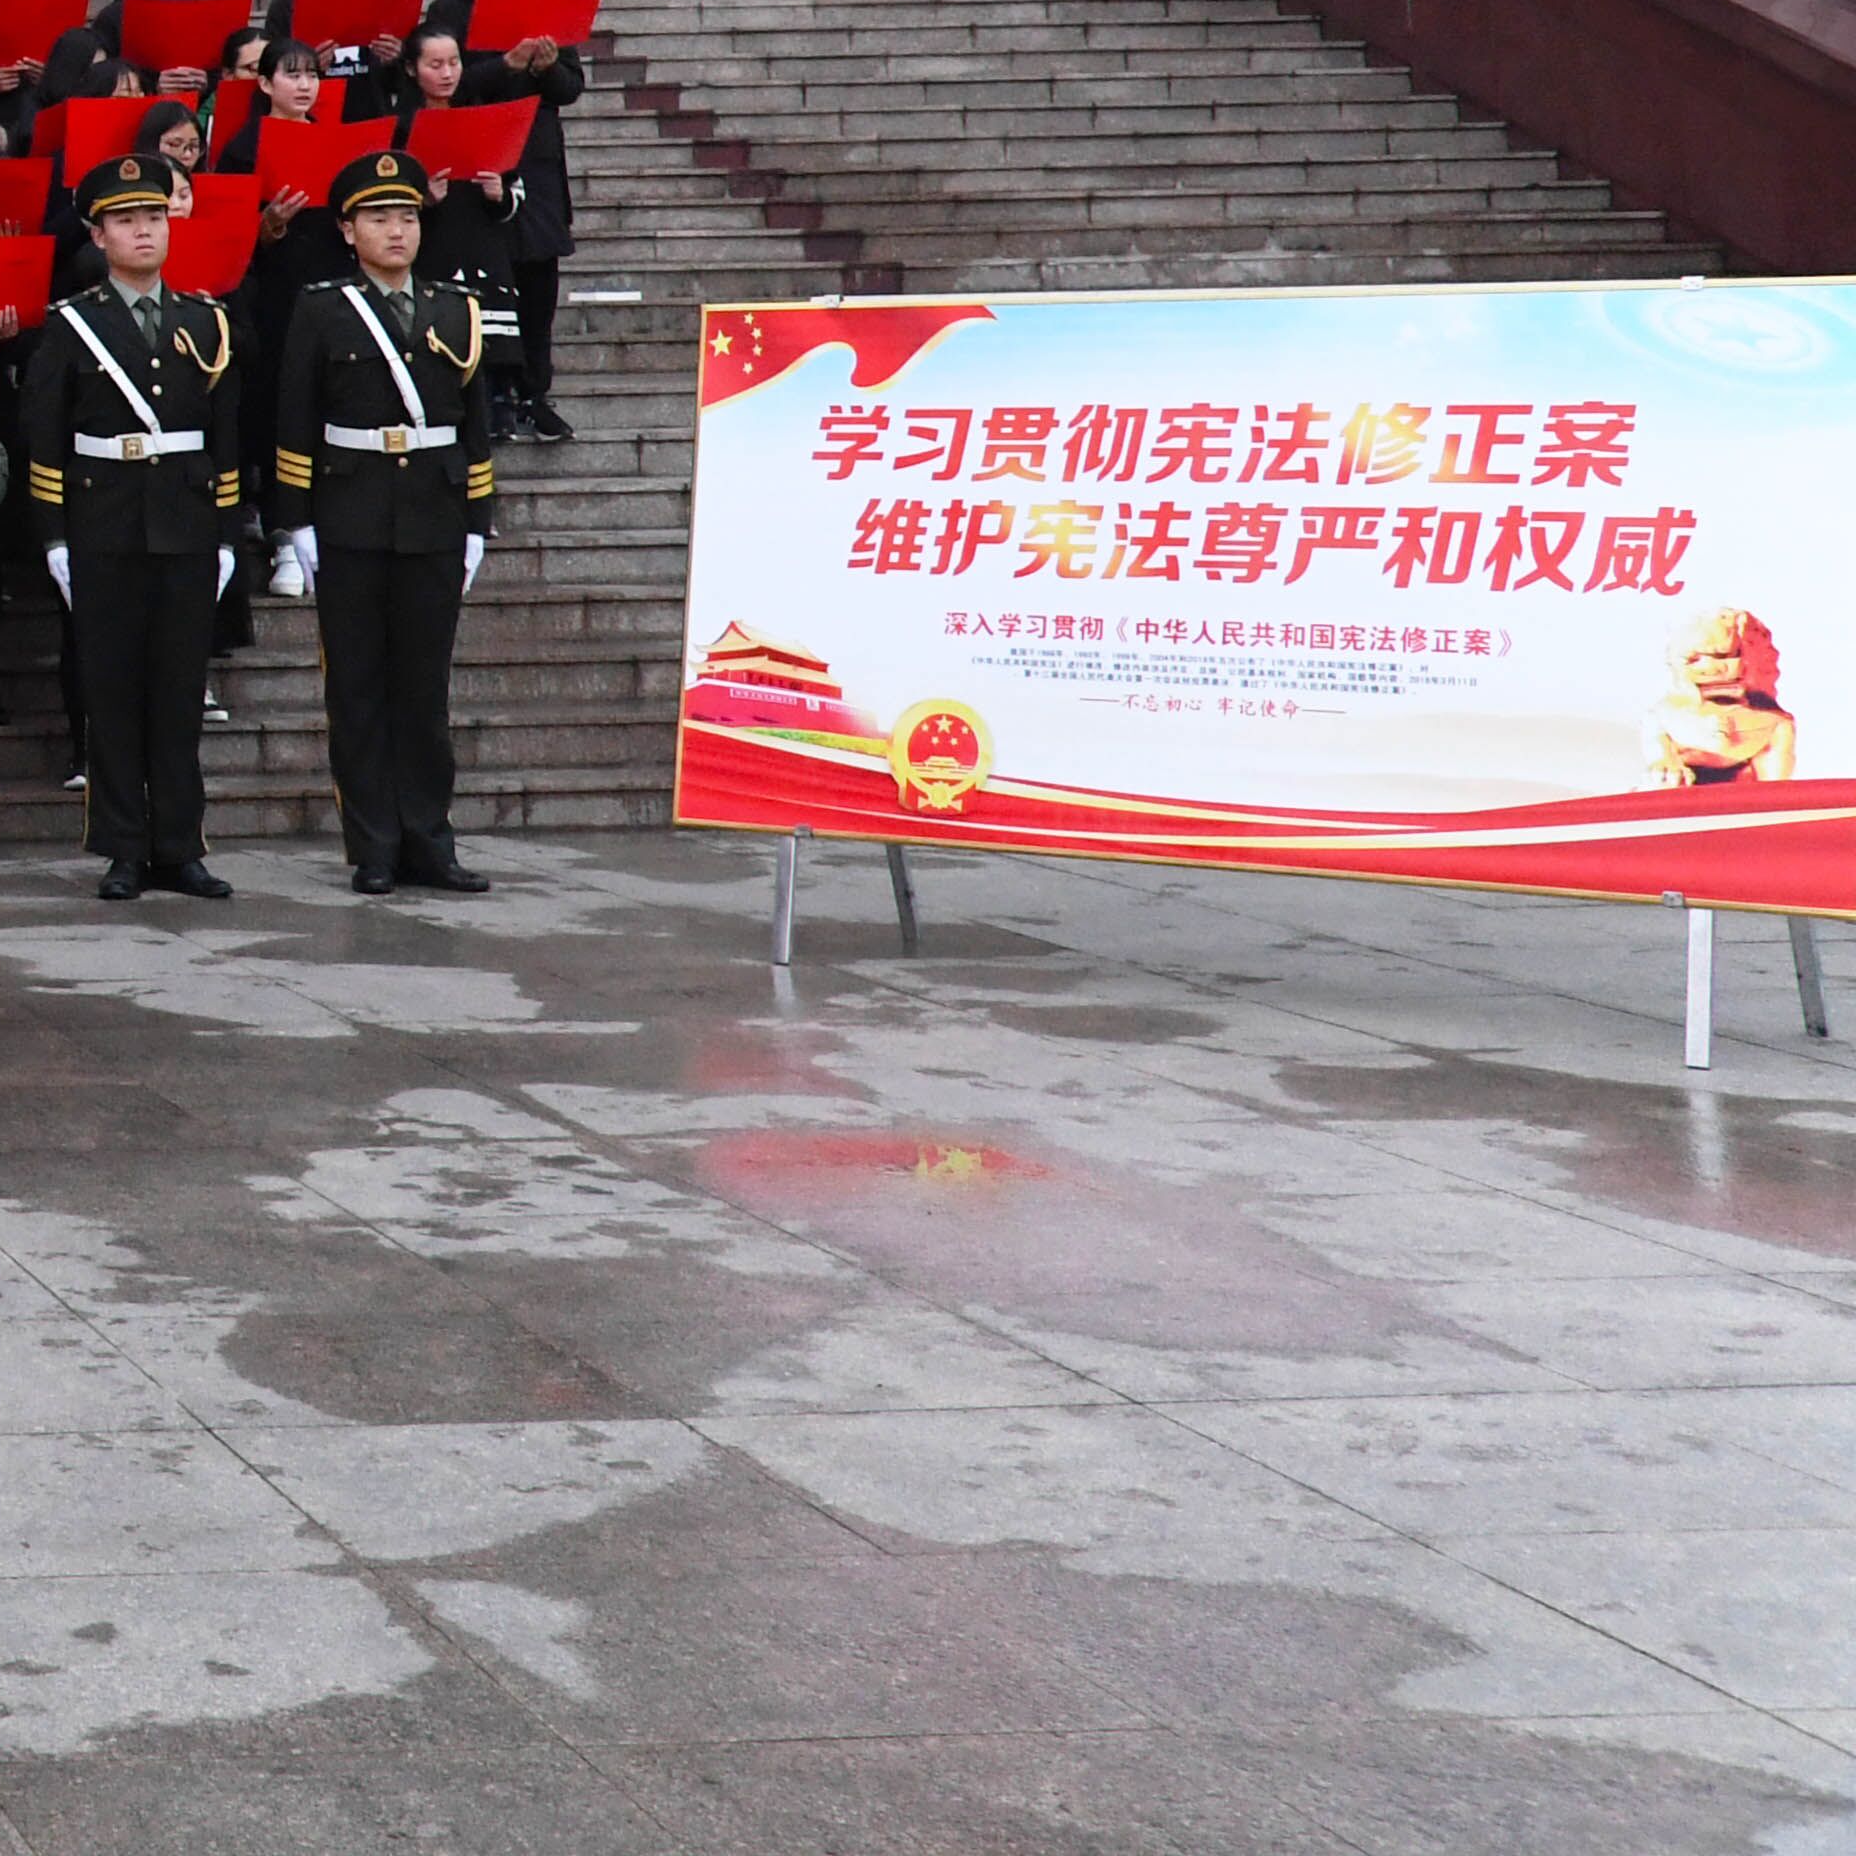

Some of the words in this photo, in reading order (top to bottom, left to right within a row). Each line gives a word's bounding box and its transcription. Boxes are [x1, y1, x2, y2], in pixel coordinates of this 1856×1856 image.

[811, 400, 1638, 488] 学习贯彻宪法修正案
[846, 497, 1698, 597] 维护宪法尊严和权威
[943, 611, 1513, 657] 深入学习贯彻《中华人民共和国宪法修正案》
